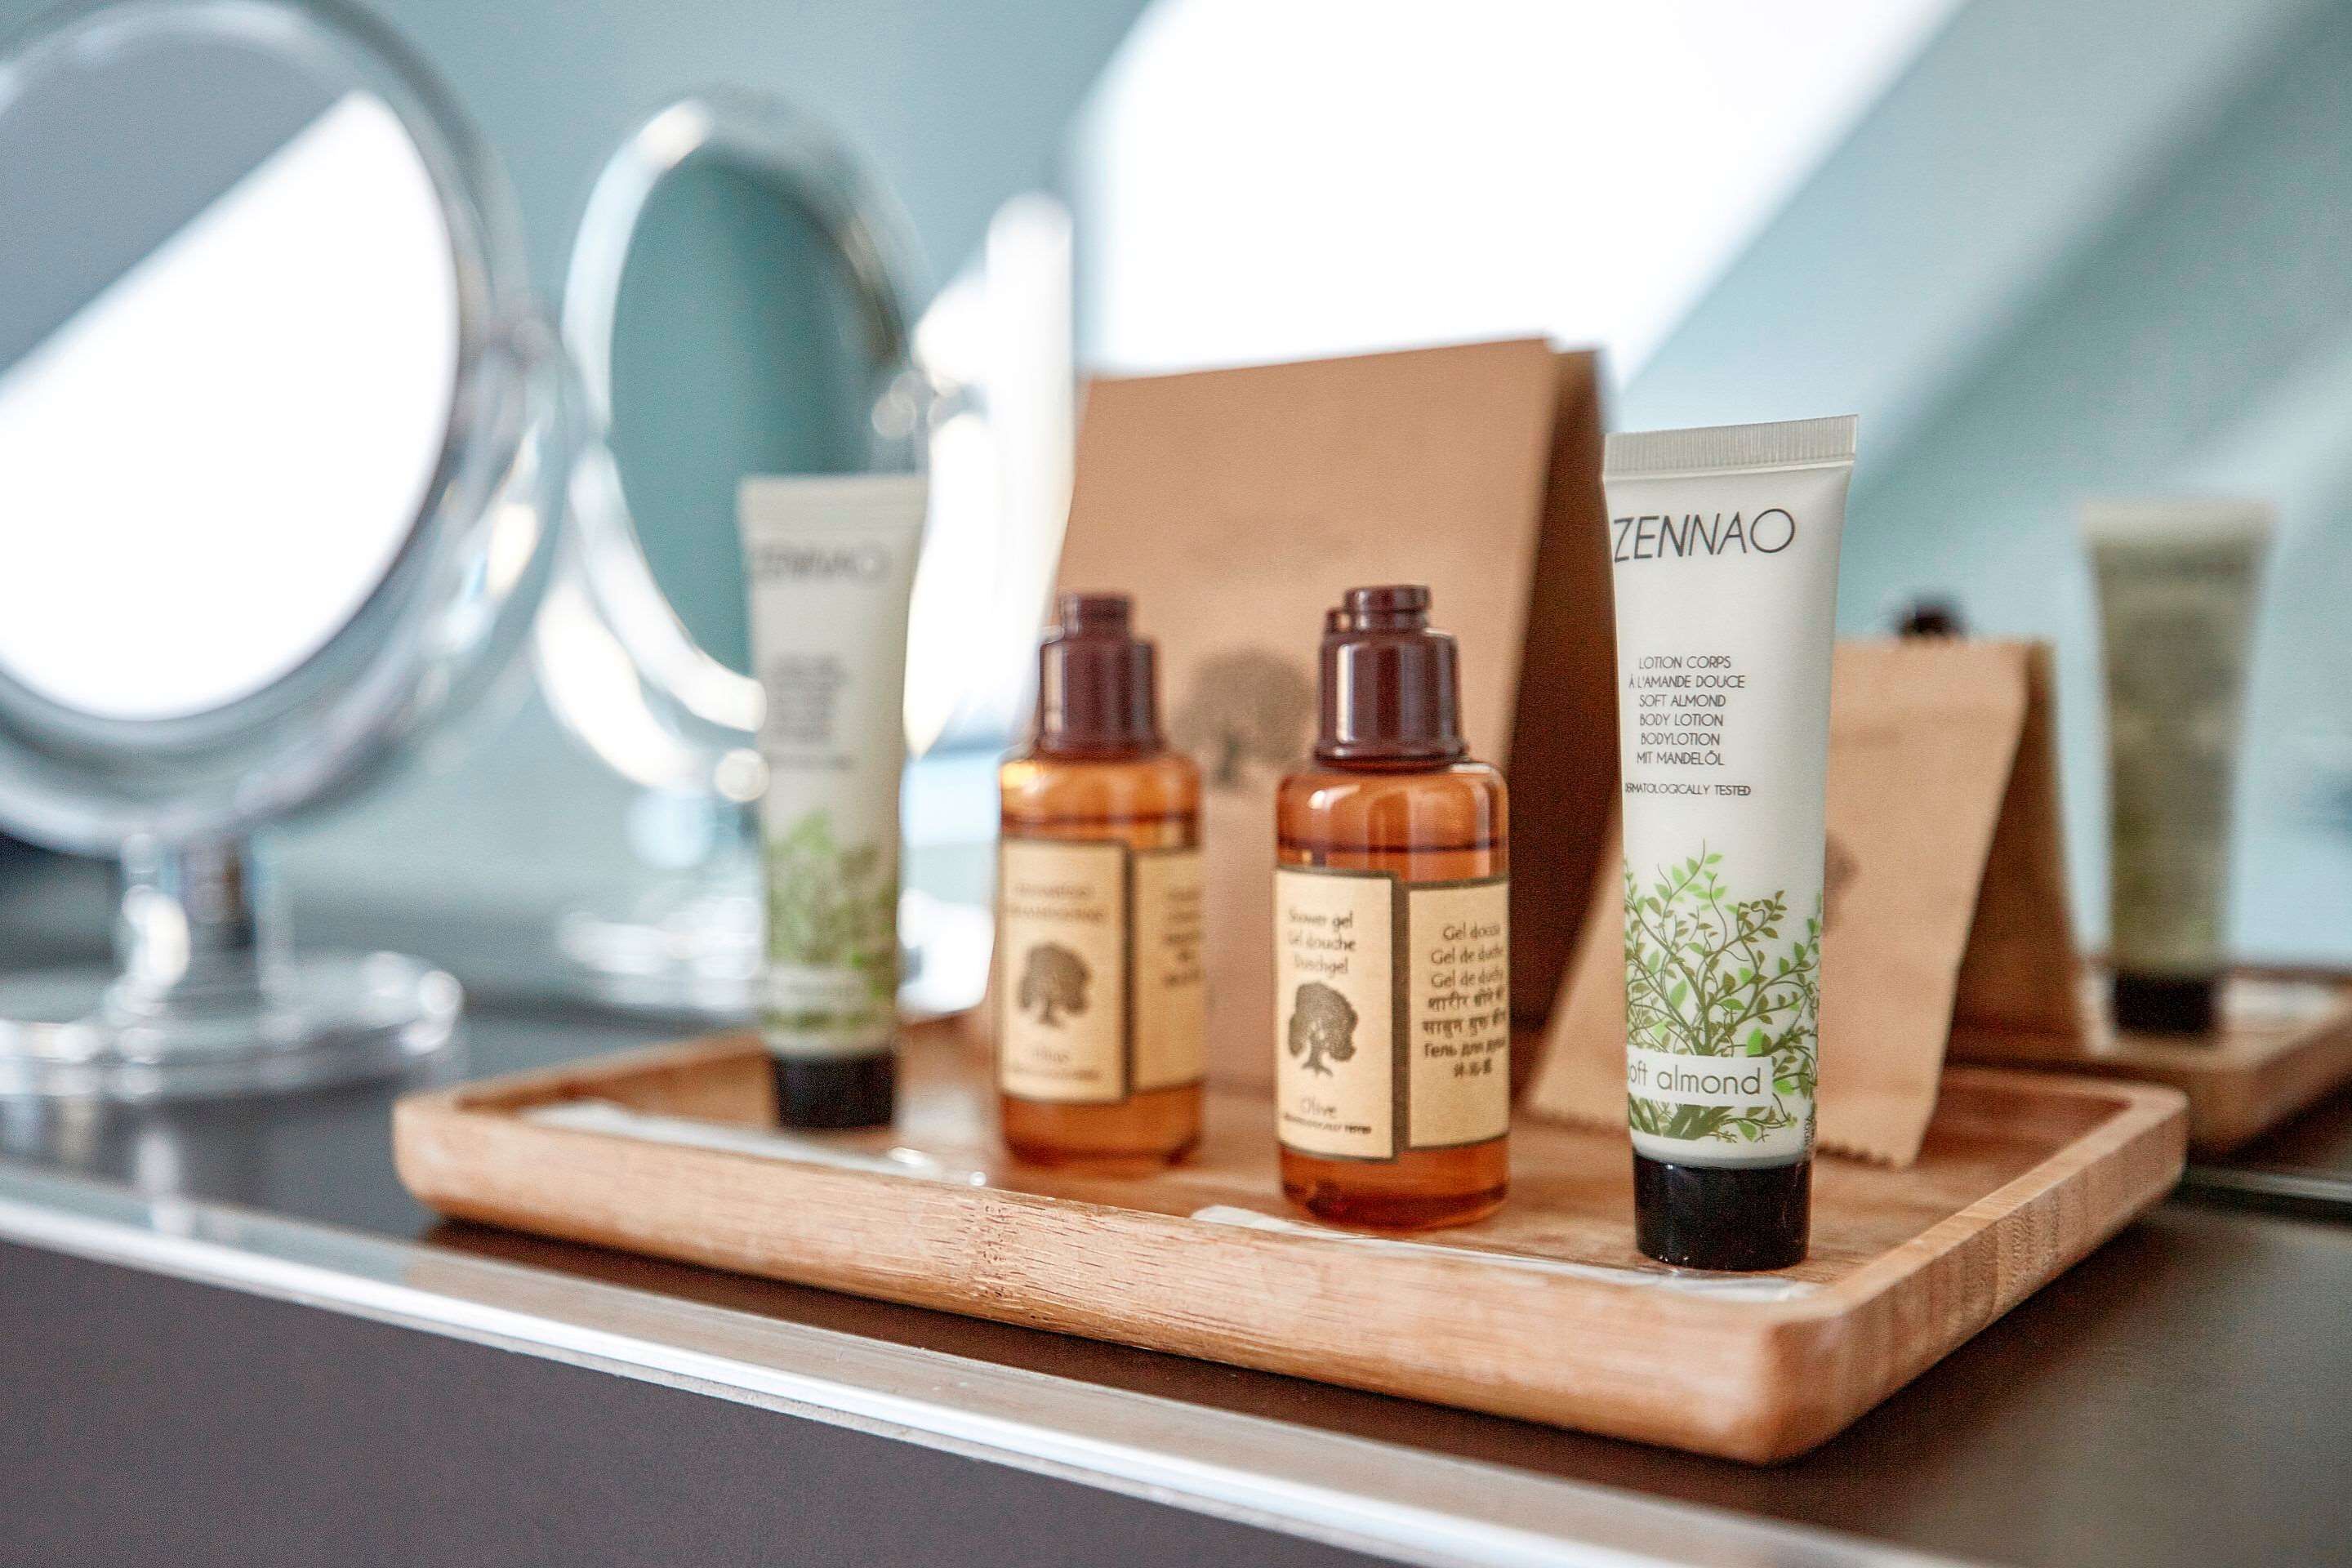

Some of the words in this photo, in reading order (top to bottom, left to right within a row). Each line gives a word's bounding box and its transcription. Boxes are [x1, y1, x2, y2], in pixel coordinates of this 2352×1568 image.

[1613, 508, 1796, 563] ZENNAO
[1639, 656, 1682, 669] LOTION
[1686, 656, 1731, 669] CORPS
[1637, 675, 1691, 688] L'AMANDE
[1695, 675, 1745, 688] DOUCE
[1639, 694, 1666, 707] SOFT
[1670, 694, 1726, 707] ALMOND
[1639, 713, 1671, 726] BODY
[1674, 713, 1724, 727] LOTION
[1641, 733, 1721, 746] BODYLOTION
[1637, 751, 1654, 764] MIT
[1656, 750, 1726, 766] MANDELÖL
[1714, 784, 1752, 797] TESTED
[1332, 910, 1353, 933] gel
[1442, 921, 1466, 941] Gel
[1430, 947, 1455, 965] Gel
[1460, 947, 1475, 964] de
[1430, 969, 1456, 988] Gel
[1460, 969, 1476, 987] de
[1628, 1060, 1648, 1086] oft
[1656, 1064, 1762, 1095] almond
